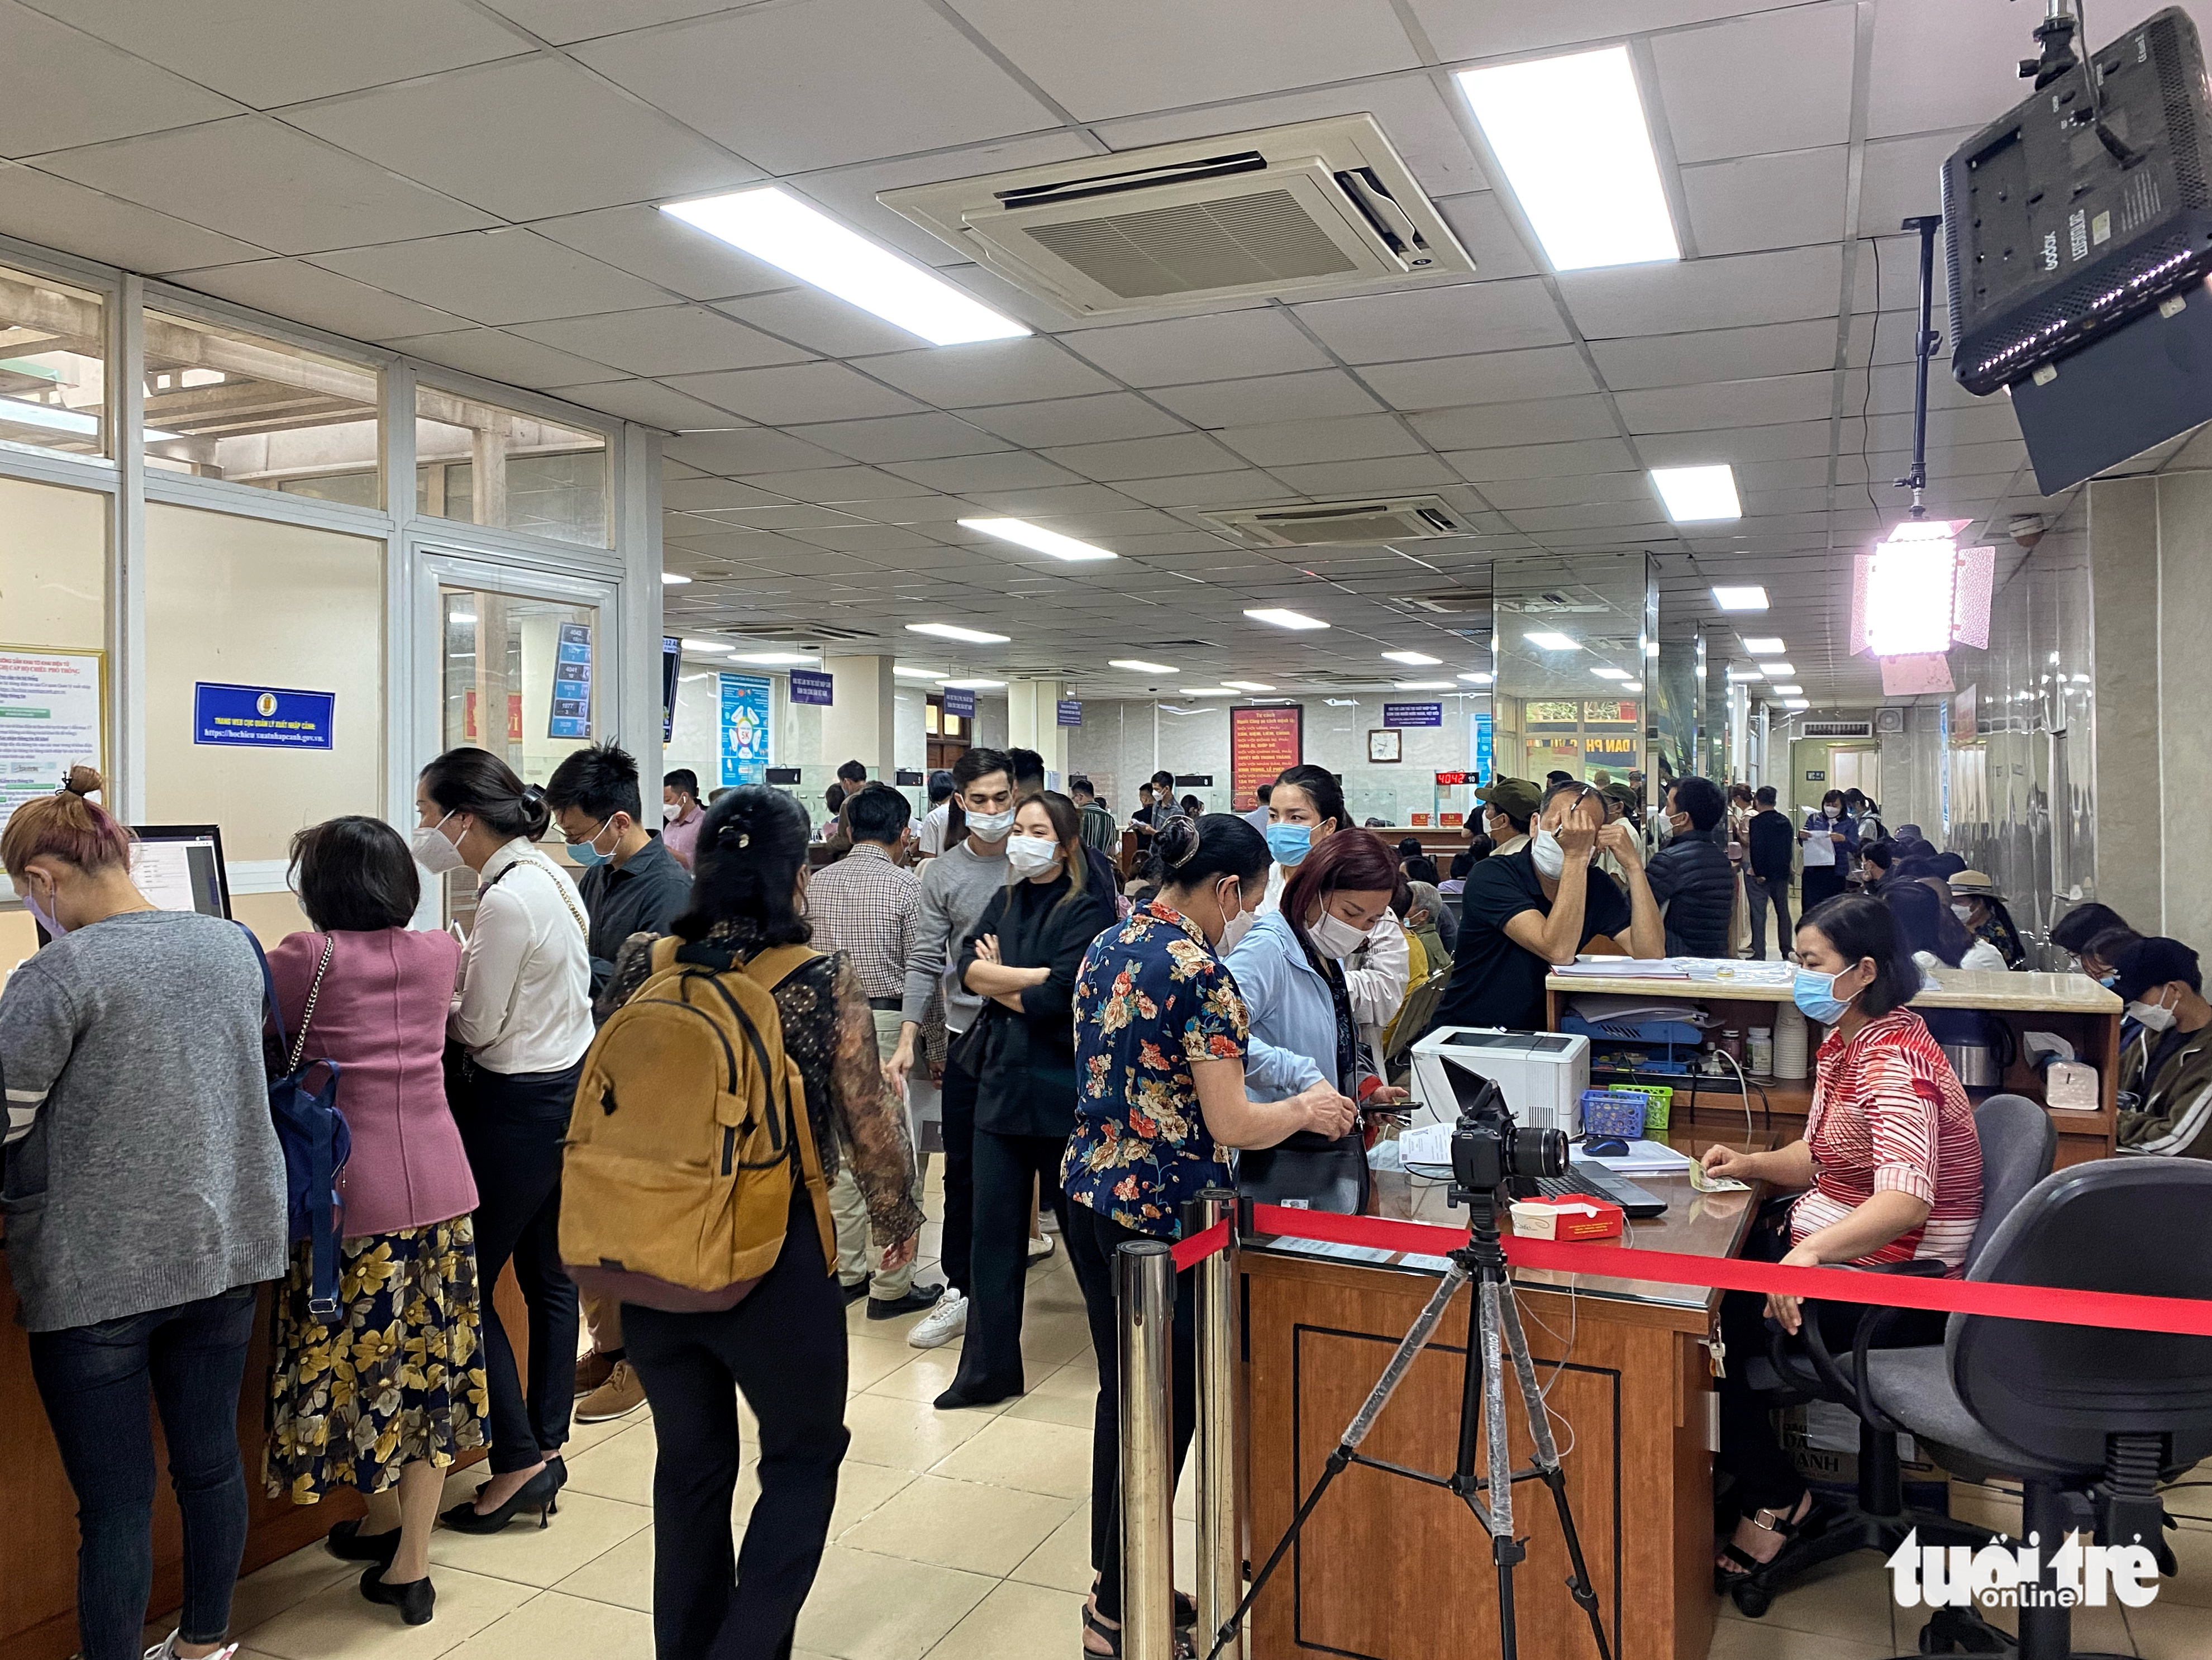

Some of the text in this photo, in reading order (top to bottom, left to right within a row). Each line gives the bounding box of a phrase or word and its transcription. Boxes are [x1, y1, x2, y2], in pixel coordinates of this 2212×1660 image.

[2040, 231, 2058, 270] Godox
[741, 731, 750, 739] 5K
[1438, 773, 1465, 783] 4042
